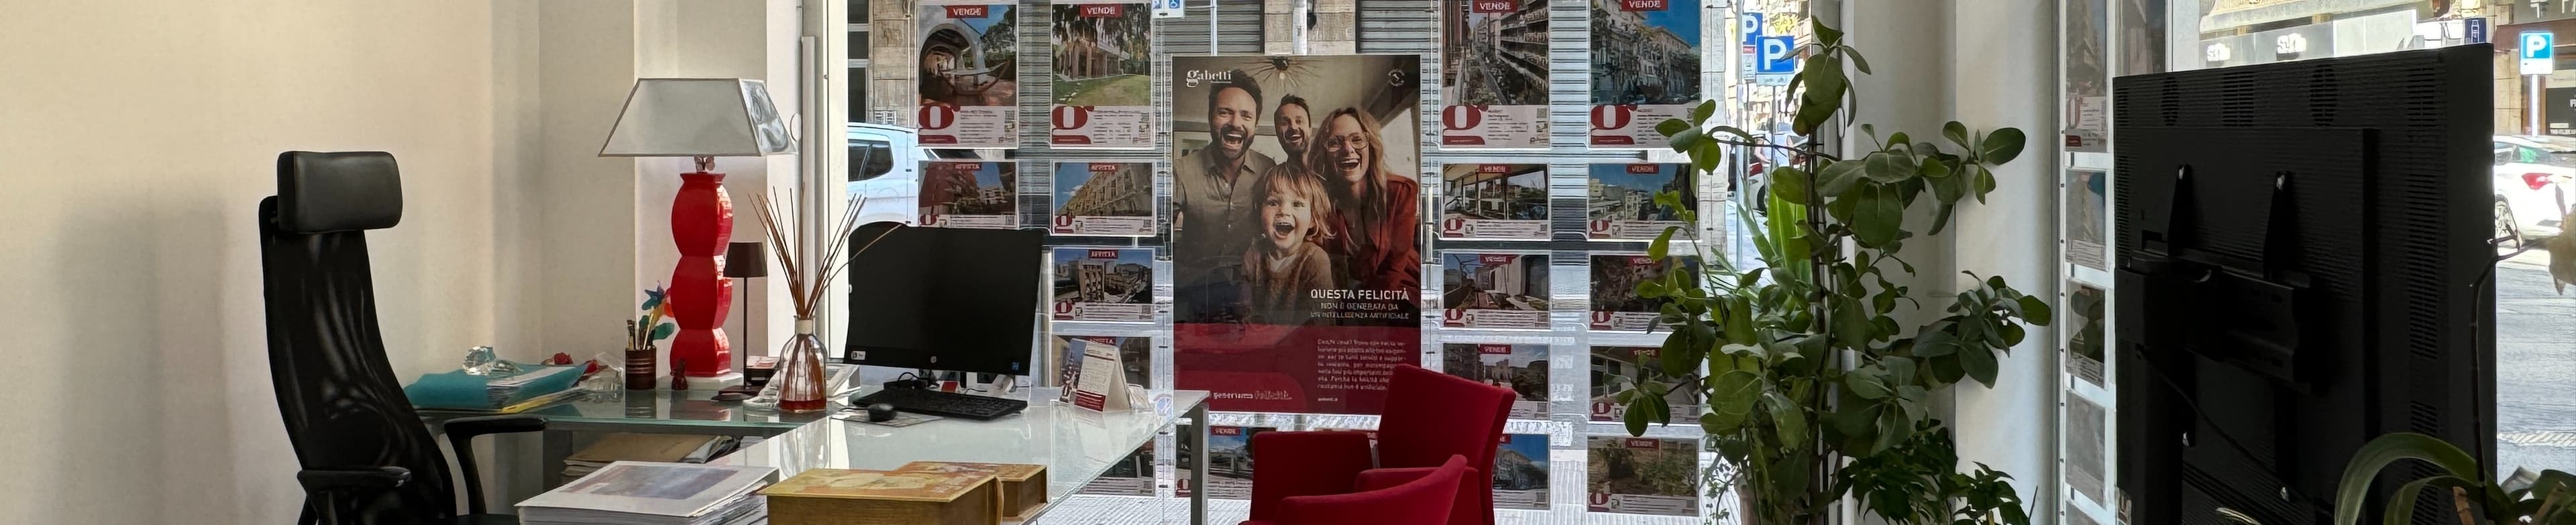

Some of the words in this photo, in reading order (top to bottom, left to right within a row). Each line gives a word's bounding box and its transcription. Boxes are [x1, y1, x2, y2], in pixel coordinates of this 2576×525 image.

[953, 7, 982, 15] VENDE
[1087, 7, 1116, 15] VENDE
[1479, 2, 1511, 10] VENDE
[1629, 0, 1661, 8] VENDE
[1742, 15, 1758, 42] P
[2526, 36, 2547, 58] P
[1764, 39, 1787, 70] P
[1186, 70, 1232, 87] gabetti
[1310, 289, 1356, 299] QUESTA
[1358, 287, 1409, 301] FELICITÀ
